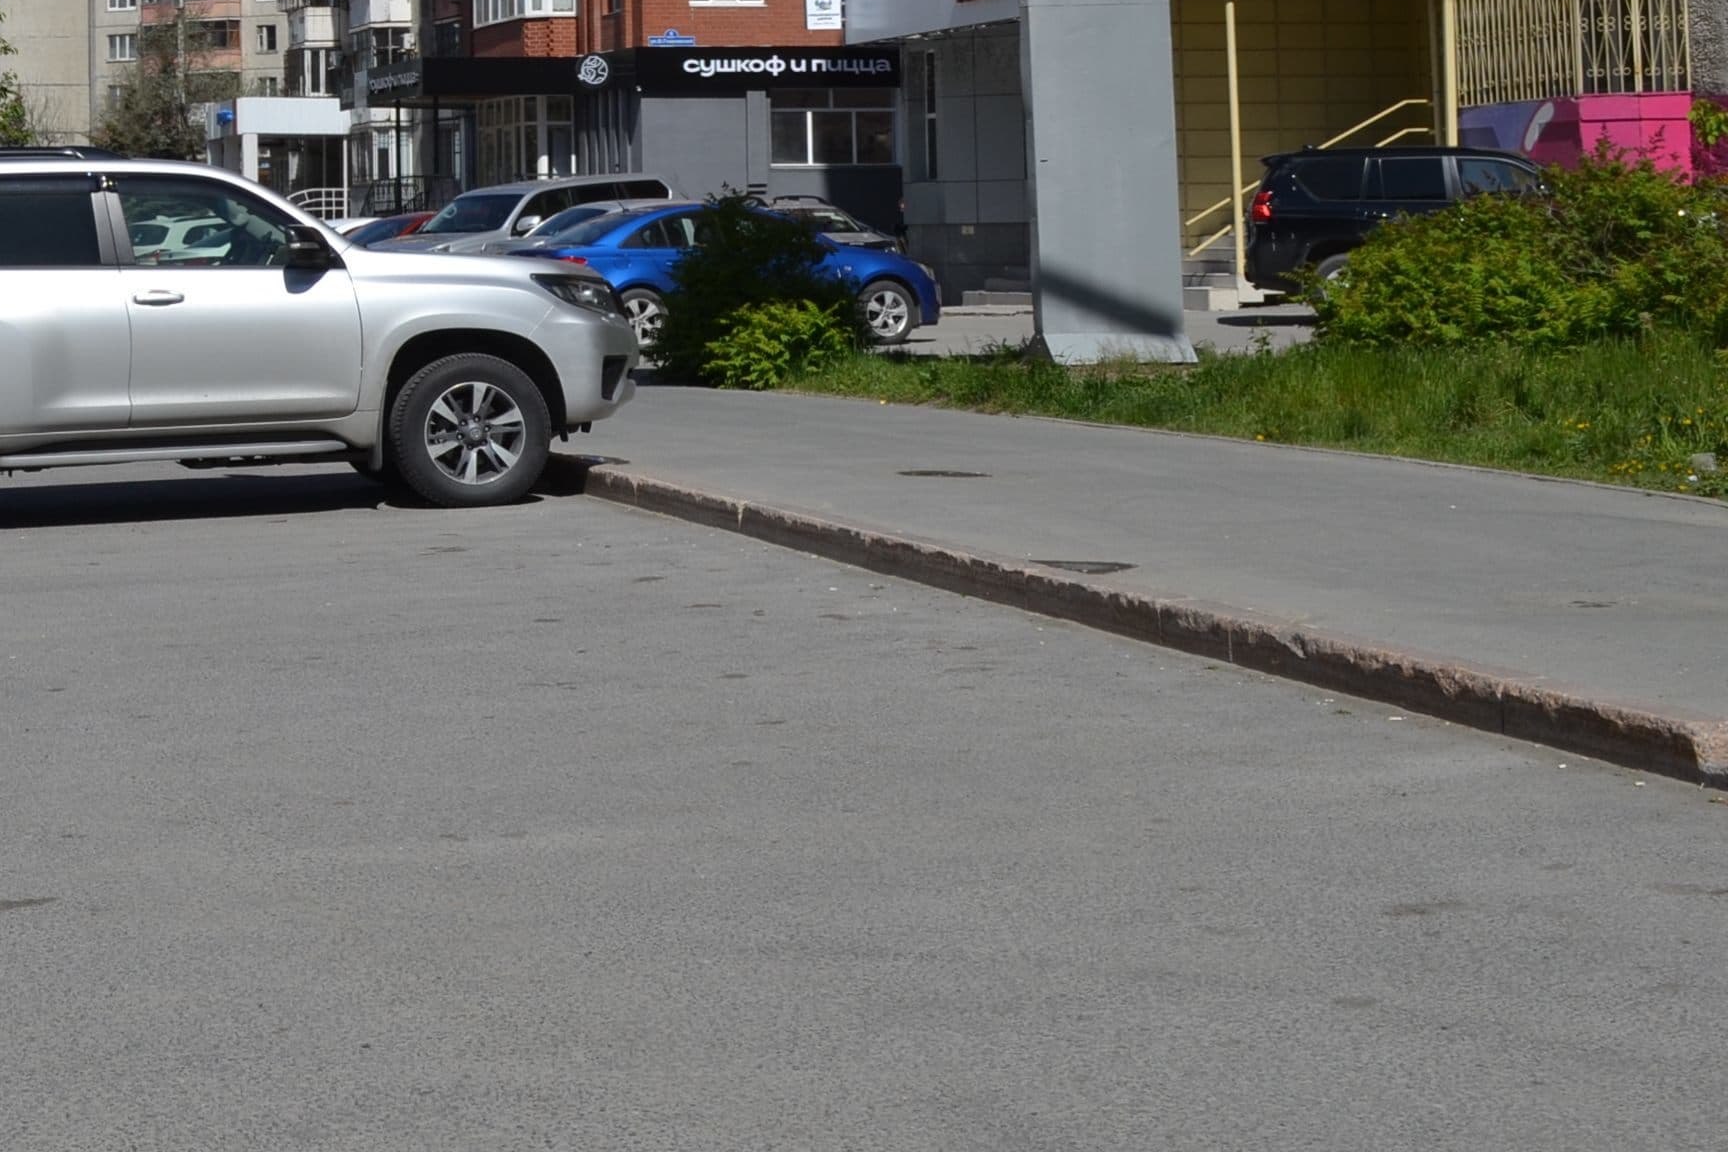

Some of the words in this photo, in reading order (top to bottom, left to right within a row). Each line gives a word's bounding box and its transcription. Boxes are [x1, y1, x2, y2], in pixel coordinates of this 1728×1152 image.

[683, 54, 787, 78] сушкоф
[790, 58, 807, 73] и
[811, 58, 892, 75] пицца
